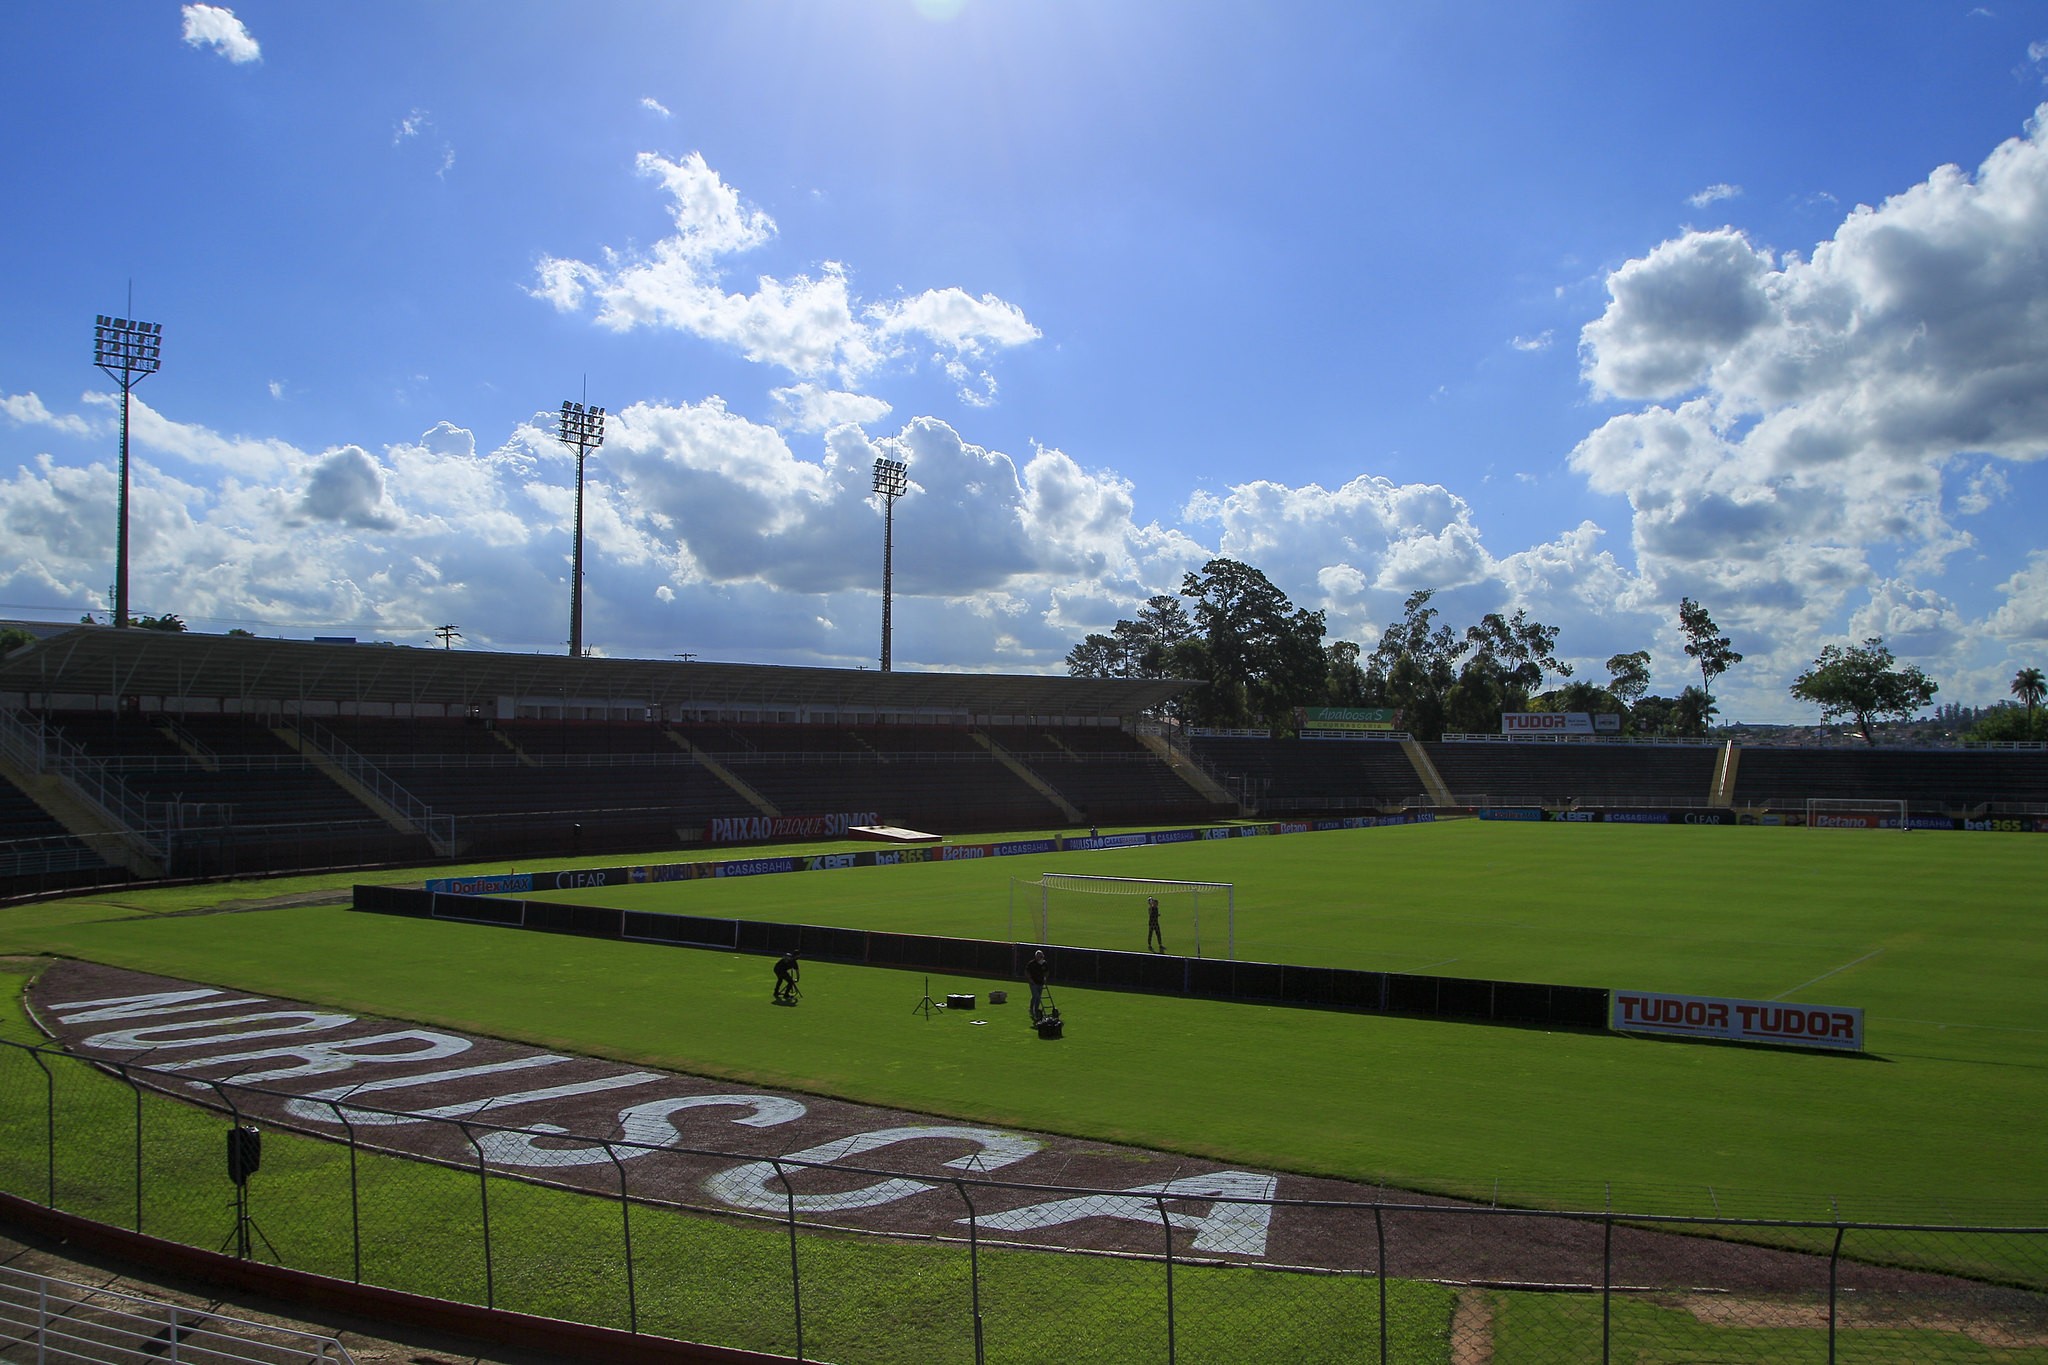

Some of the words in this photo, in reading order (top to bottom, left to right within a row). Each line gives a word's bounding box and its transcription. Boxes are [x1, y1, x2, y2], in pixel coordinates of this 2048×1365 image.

[1505, 716, 1566, 728] TUDOR
[1684, 813, 1721, 825] CLEAR
[1816, 815, 1867, 828] Betano
[1964, 818, 2022, 831] bet365
[875, 850, 924, 867] bet365
[943, 845, 984, 861] Betano
[1618, 997, 1729, 1027] TUDOR
[1736, 1005, 1854, 1038] TUDOR
